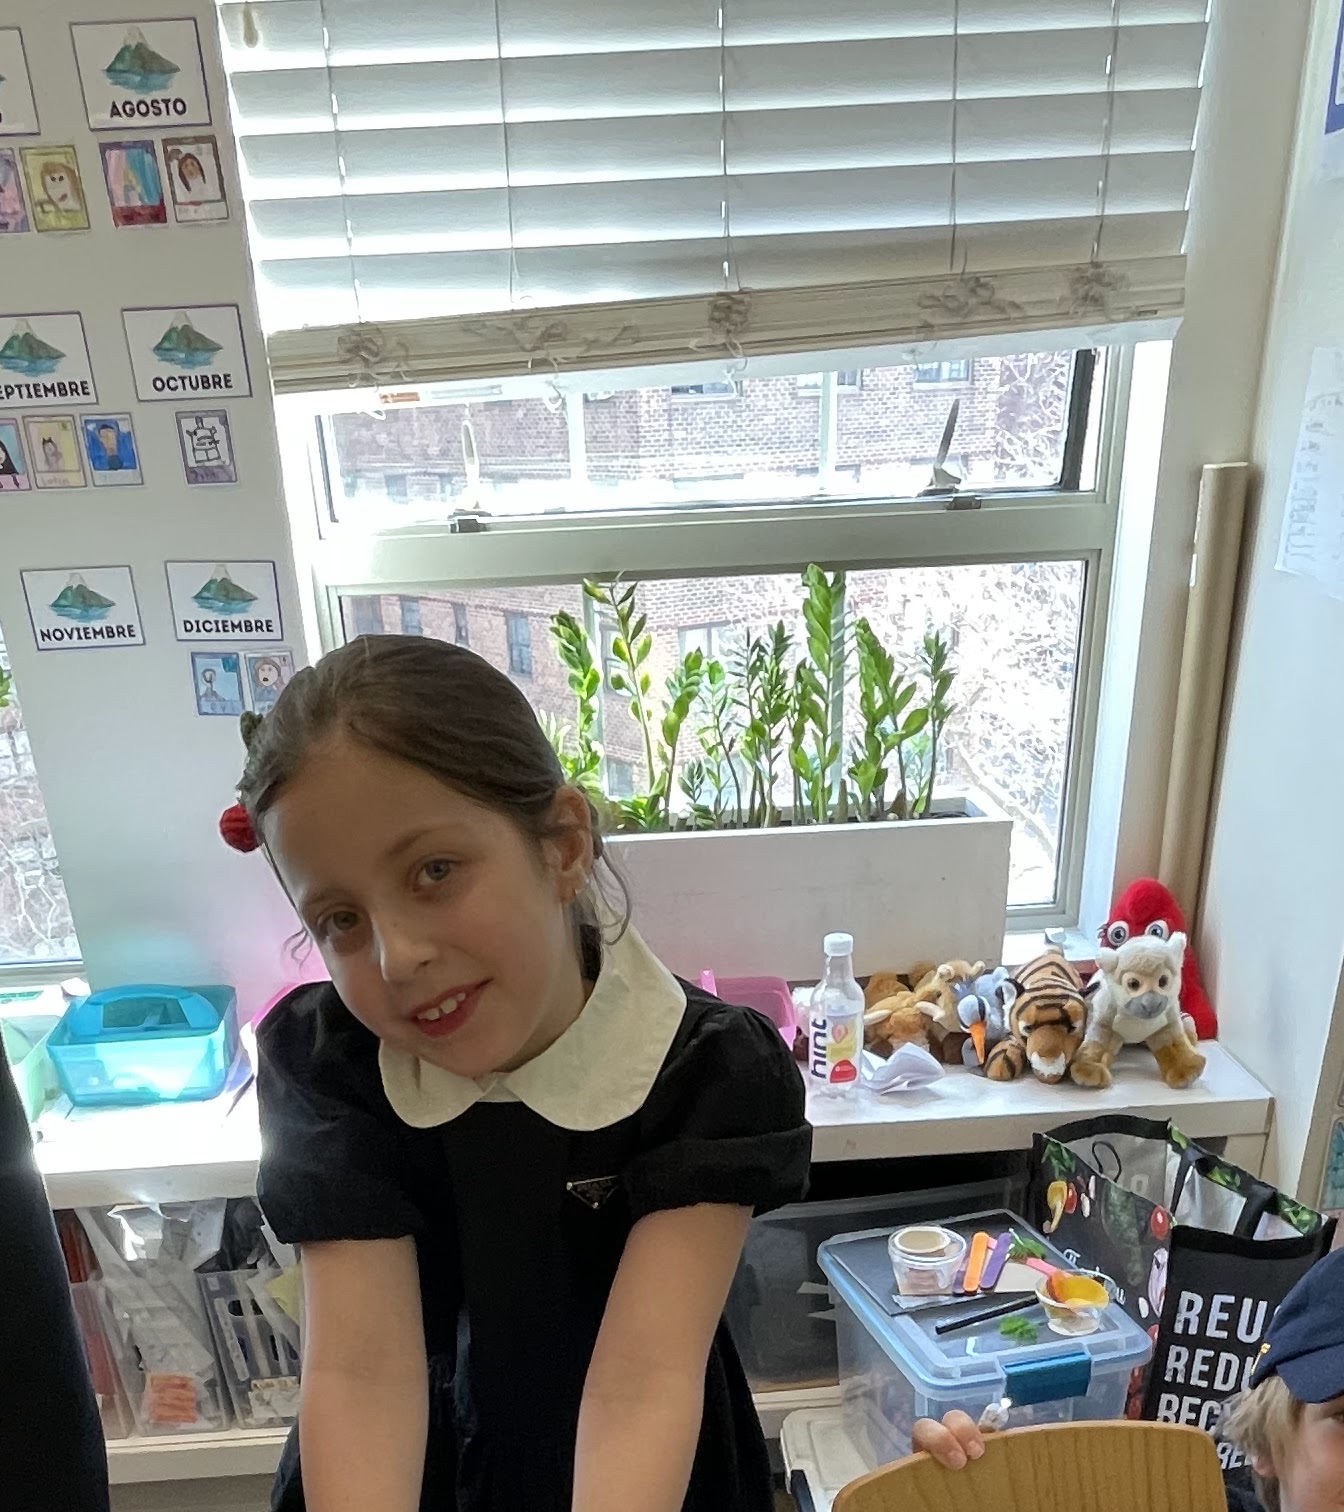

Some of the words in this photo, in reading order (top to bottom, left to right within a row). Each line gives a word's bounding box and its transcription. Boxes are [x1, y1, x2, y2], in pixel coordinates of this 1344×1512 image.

[109, 97, 187, 119] AGOSTO
[152, 373, 234, 393] OCTUBRE
[40, 624, 137, 643] NOVIEMBRE
[182, 619, 275, 635] DICIEMBRE
[811, 1017, 827, 1080] hint
[1173, 1290, 1278, 1344] REU
